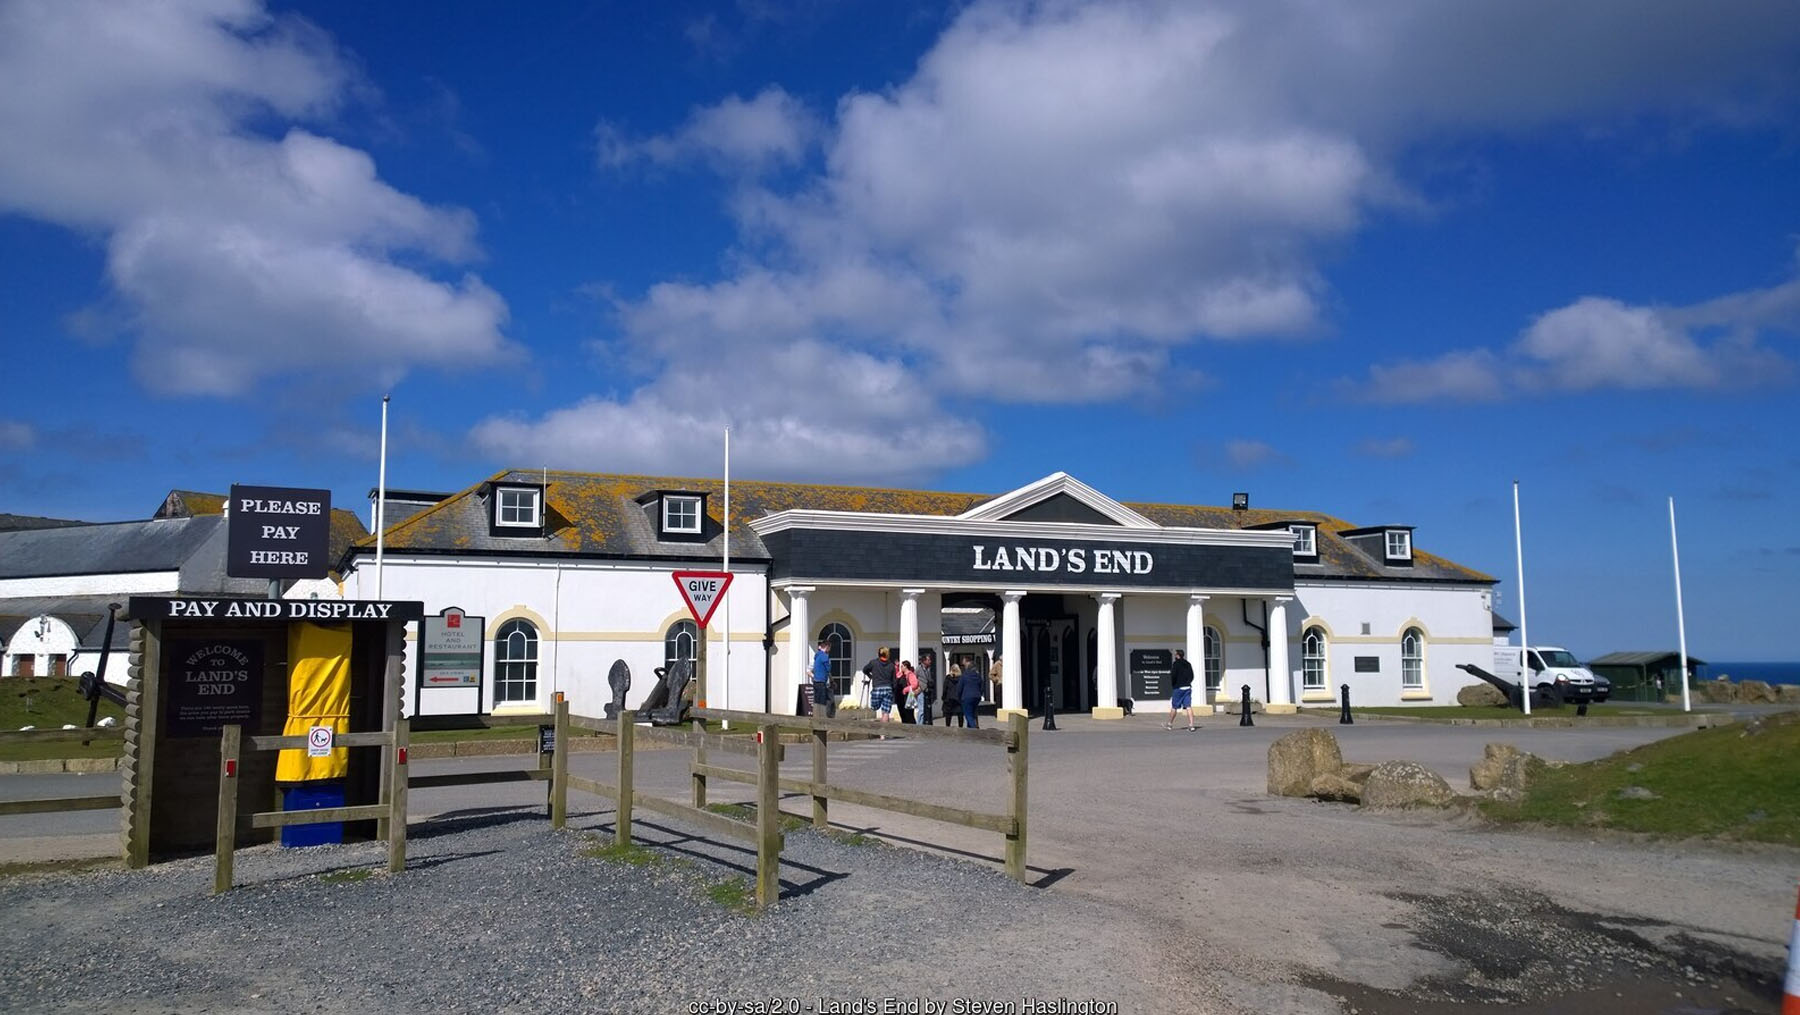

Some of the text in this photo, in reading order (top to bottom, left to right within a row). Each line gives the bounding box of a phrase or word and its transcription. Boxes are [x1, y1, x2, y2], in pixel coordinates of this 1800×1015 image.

[240, 498, 321, 515] PLEASE
[261, 525, 300, 539] PAY
[249, 550, 308, 565] HERE
[972, 545, 1154, 574] LAND'S END
[688, 579, 717, 593] GIVE
[693, 593, 712, 602] WAY
[168, 600, 393, 619] PAY AND DISPLAY
[961, 634, 992, 644] SHOPPING
[185, 644, 249, 666] WELCOME
[209, 658, 225, 666] TO
[185, 670, 249, 682] LAND'S
[197, 684, 236, 695] END
